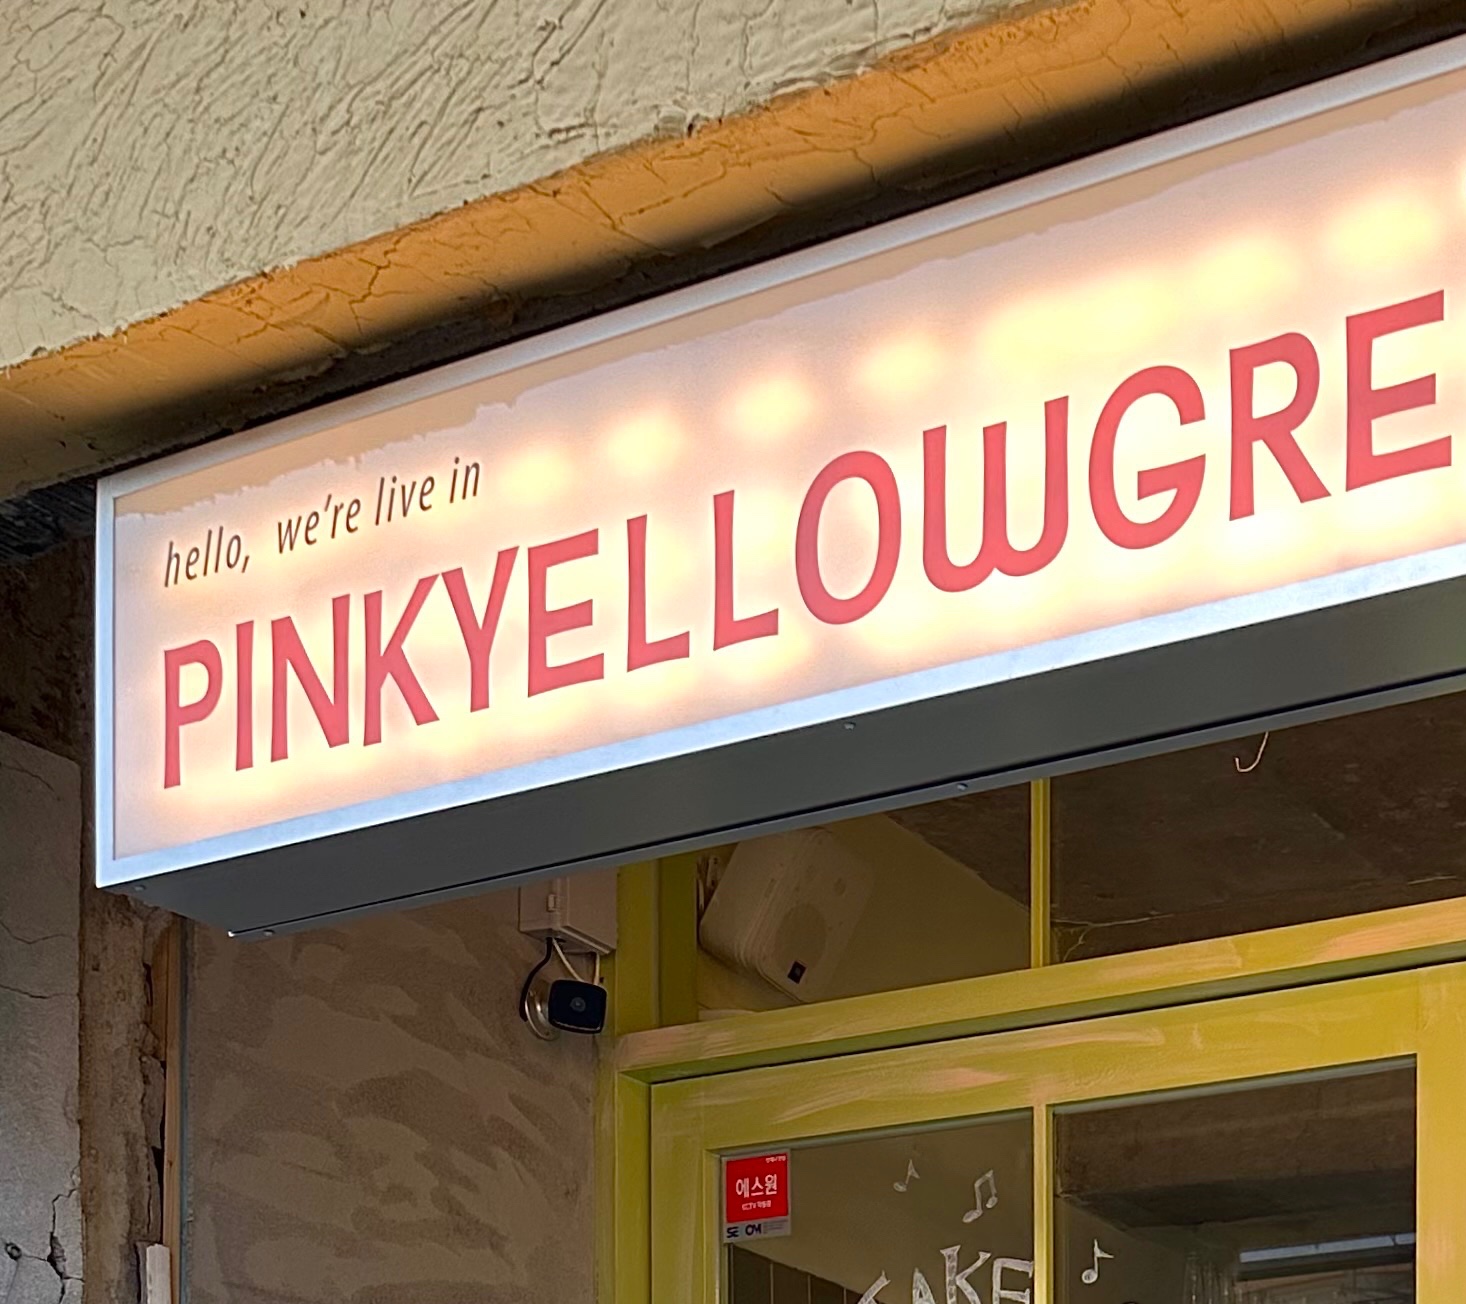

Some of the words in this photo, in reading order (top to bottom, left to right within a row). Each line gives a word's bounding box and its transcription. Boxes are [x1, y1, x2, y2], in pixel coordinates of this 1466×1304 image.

[163, 527, 252, 588] hello,
[276, 494, 361, 555] we're
[373, 475, 435, 527] live
[448, 457, 482, 503] in
[735, 1173, 777, 1198] 에스원
